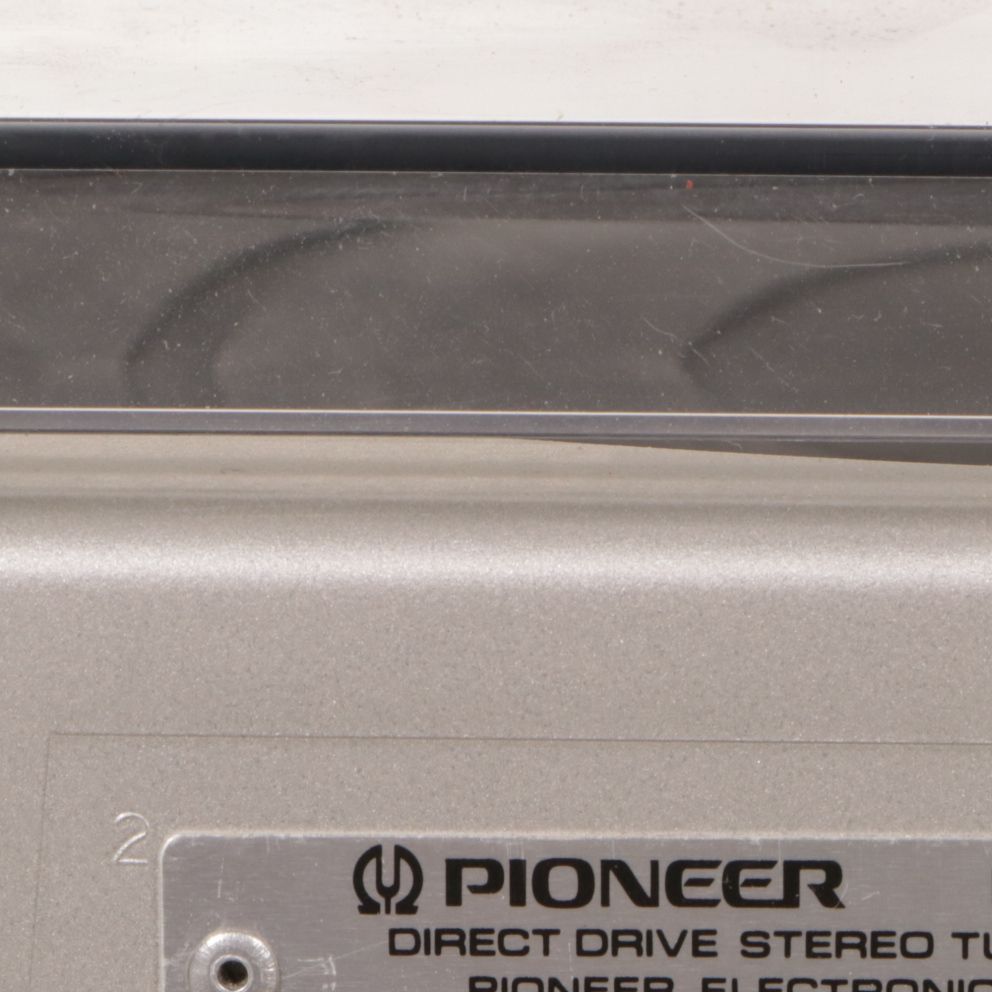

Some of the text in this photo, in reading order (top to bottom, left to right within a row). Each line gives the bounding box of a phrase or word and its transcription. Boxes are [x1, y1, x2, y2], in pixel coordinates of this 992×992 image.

[445, 858, 845, 909] PIONEER
[388, 928, 561, 957] DIRECT
[576, 929, 718, 958] DRIVE
[740, 930, 934, 959] STEREO
